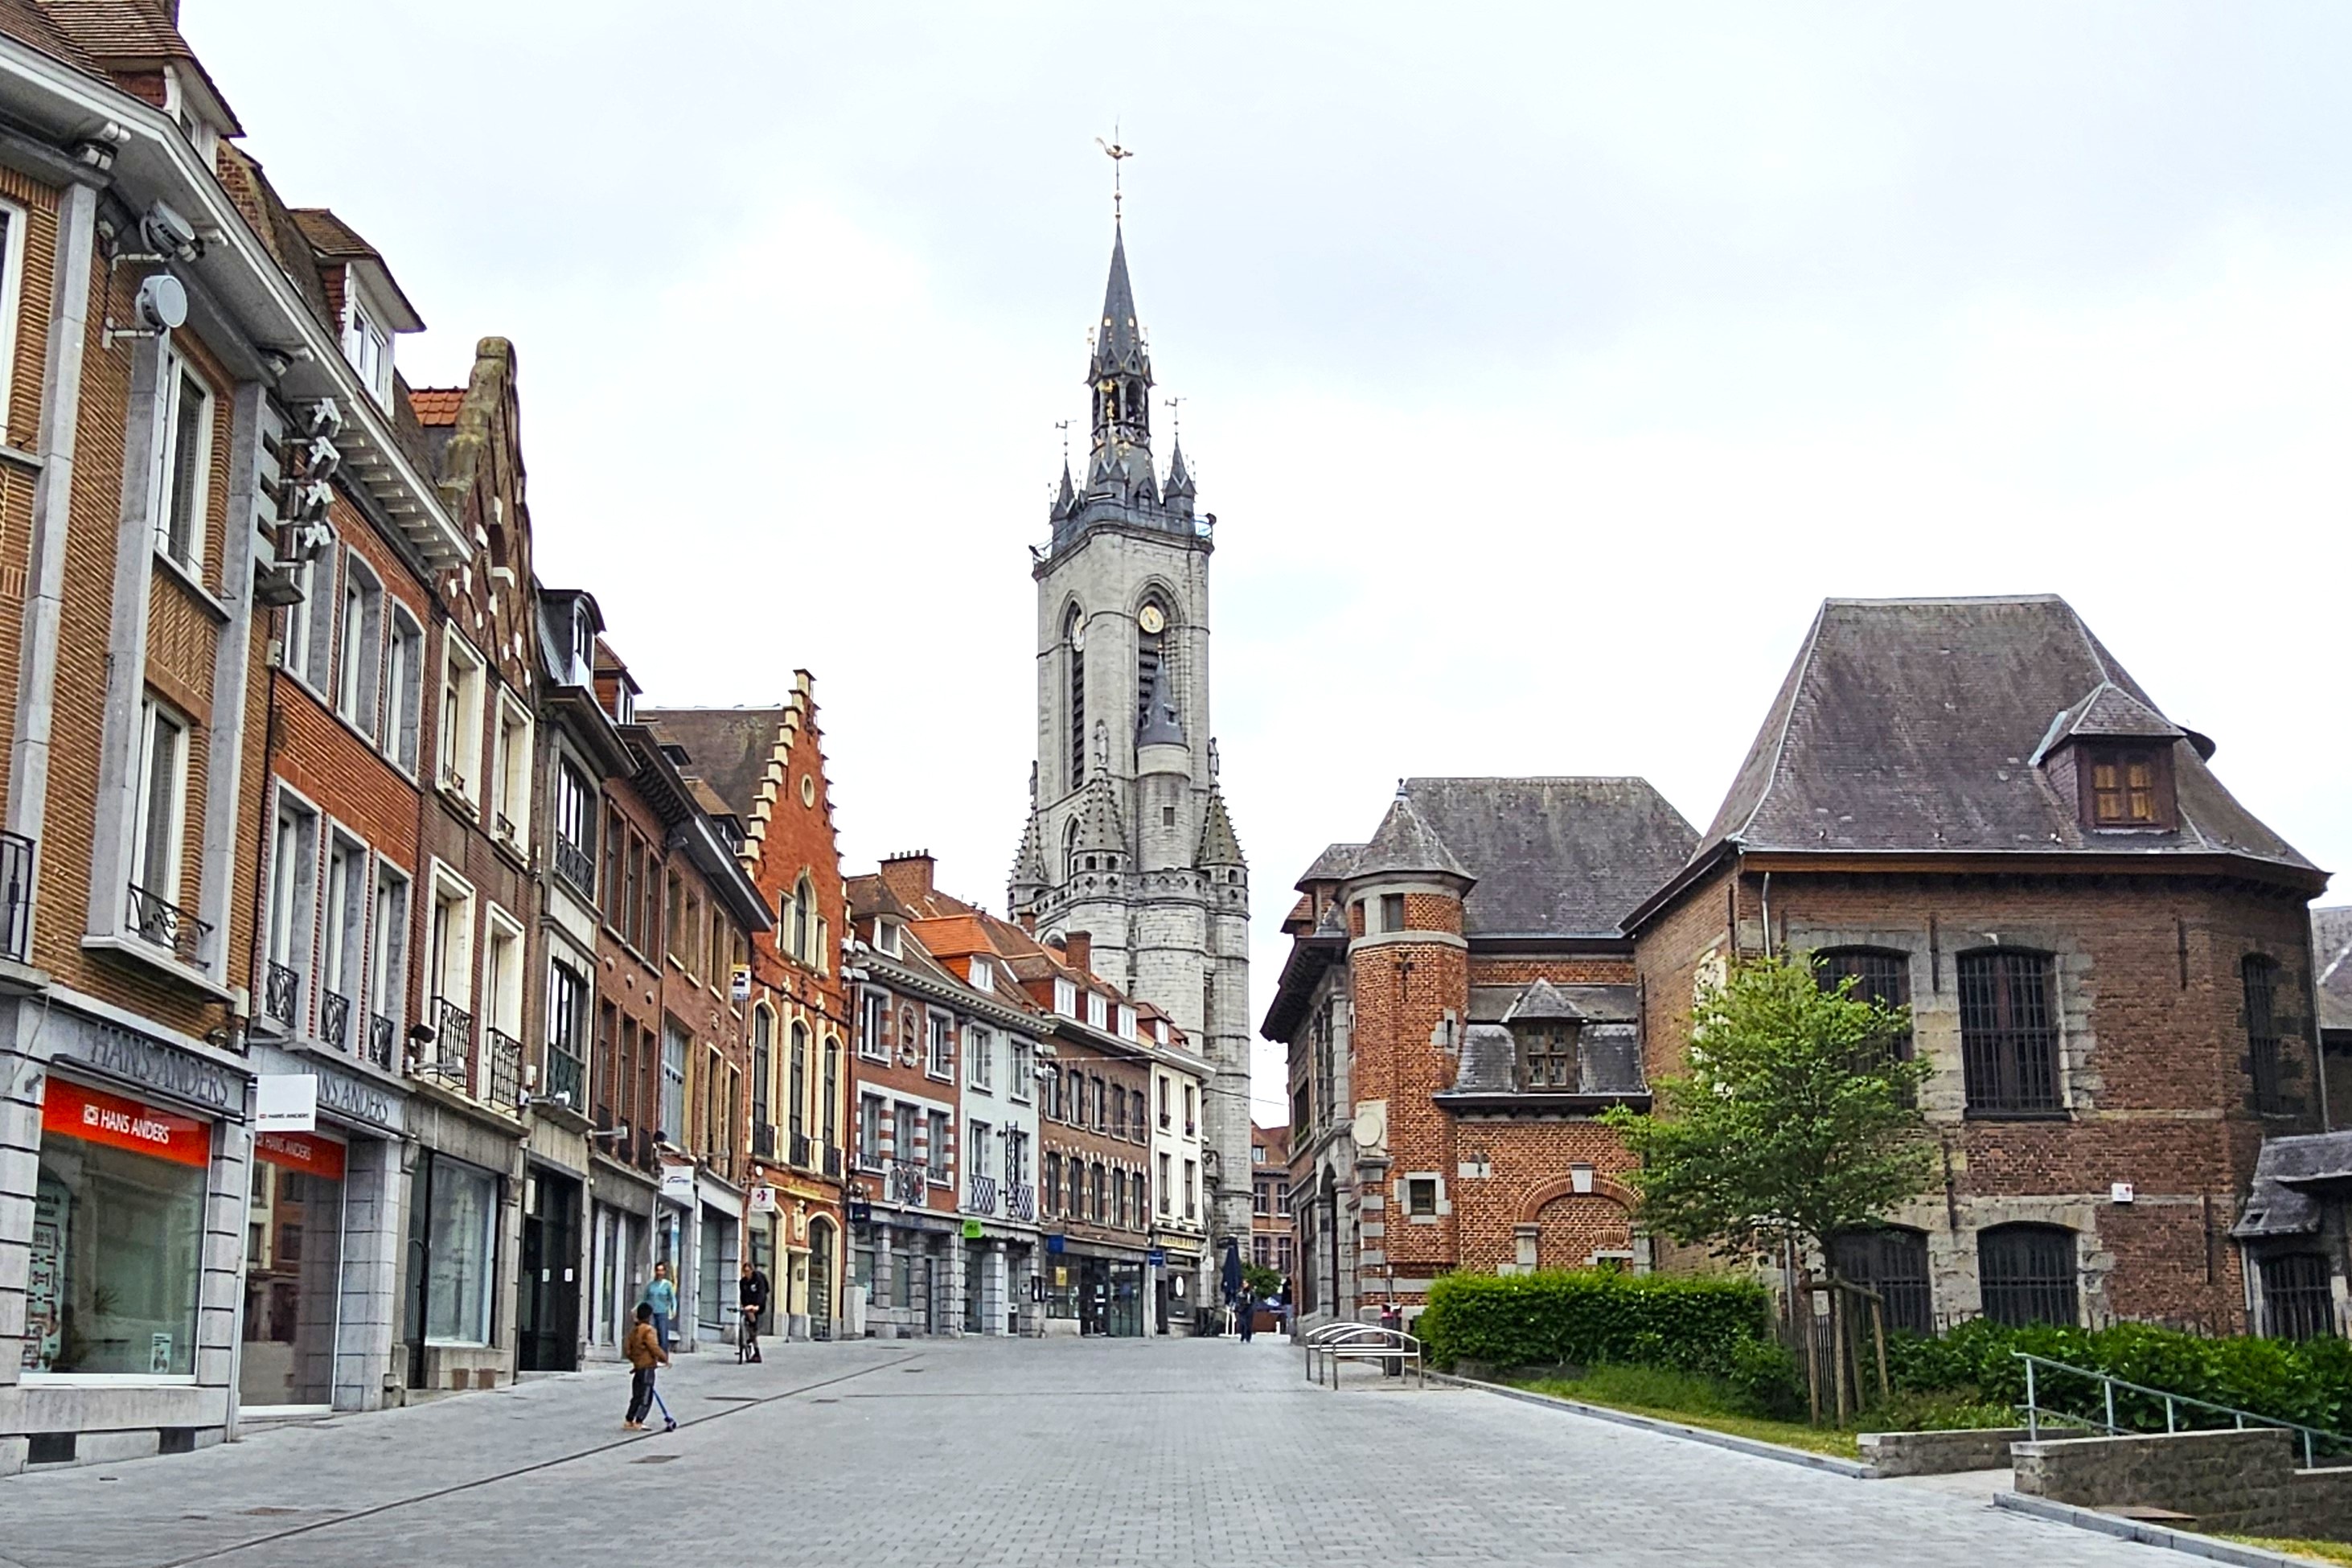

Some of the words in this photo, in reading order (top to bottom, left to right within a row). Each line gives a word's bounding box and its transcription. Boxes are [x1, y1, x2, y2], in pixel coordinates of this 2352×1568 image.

[90, 1022, 154, 1081] HANS
[154, 1047, 230, 1106] ANDERS
[340, 1082, 389, 1124] ANDERS
[101, 1109, 129, 1134] HANS
[130, 1118, 170, 1144] ANDERS
[265, 1134, 285, 1153] HANS
[285, 1140, 311, 1161] ANDERS
